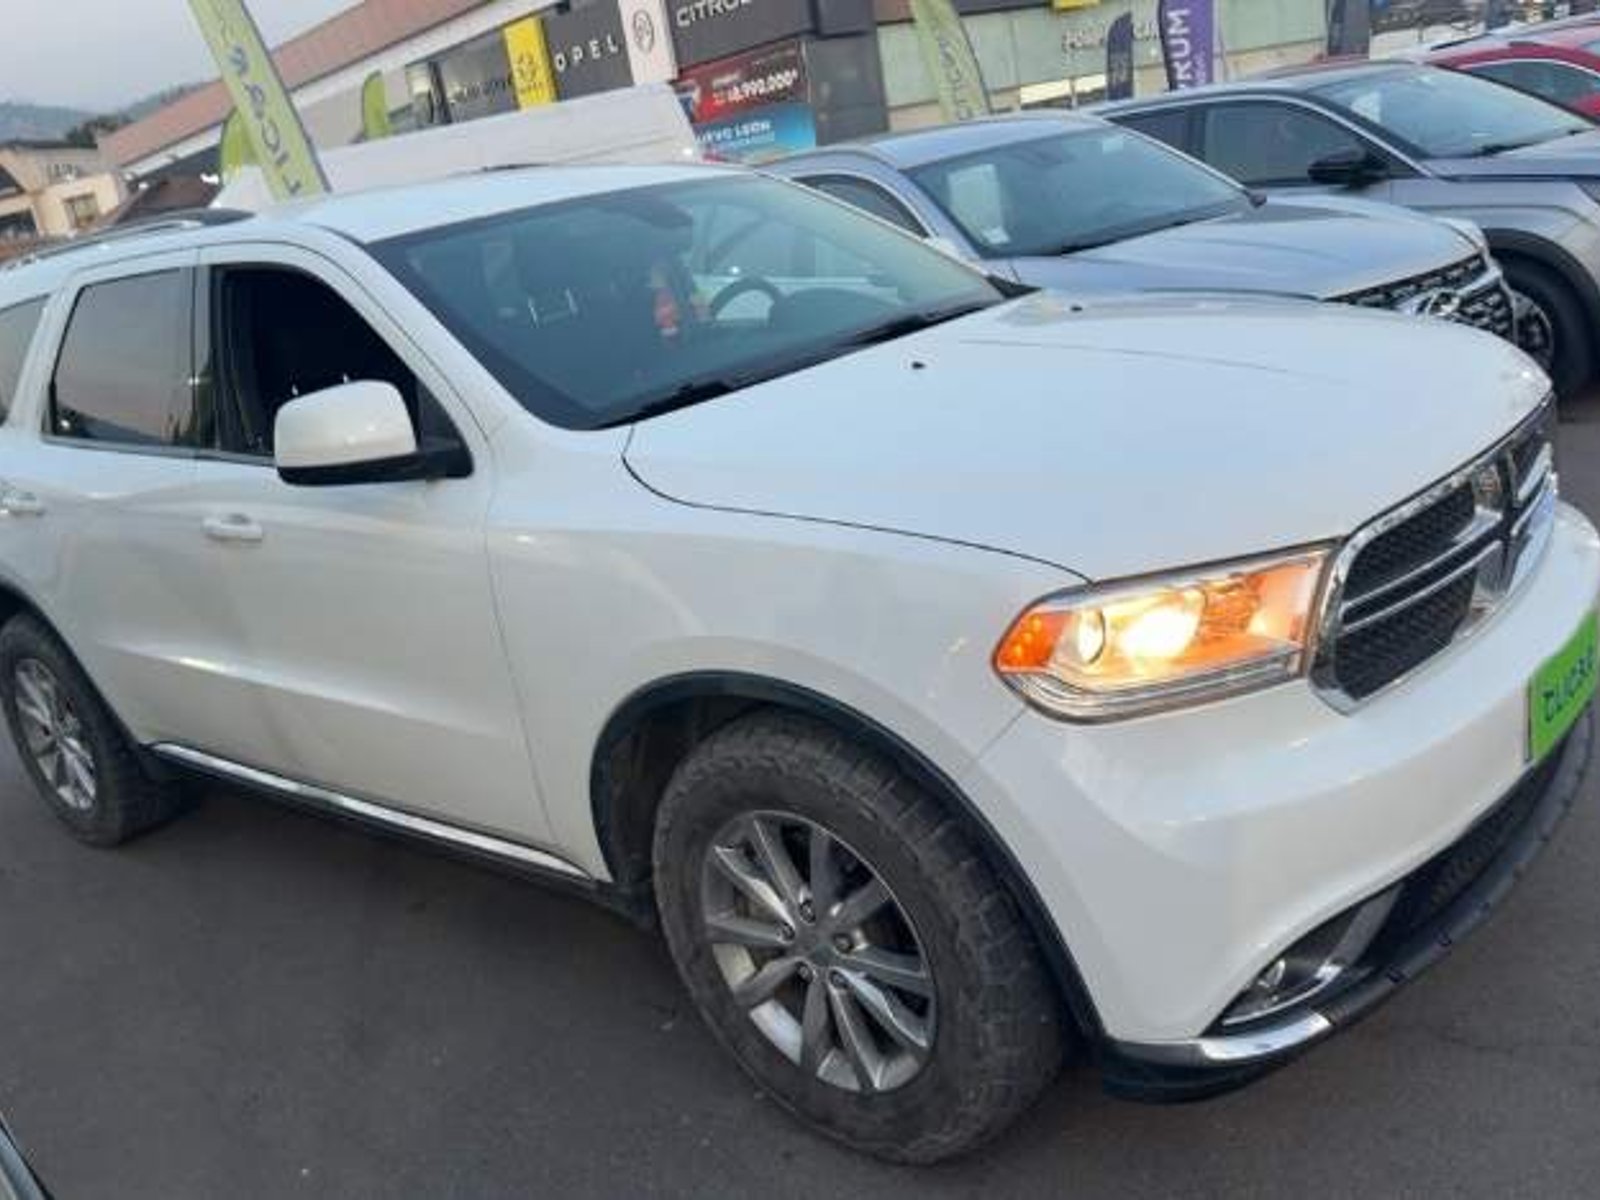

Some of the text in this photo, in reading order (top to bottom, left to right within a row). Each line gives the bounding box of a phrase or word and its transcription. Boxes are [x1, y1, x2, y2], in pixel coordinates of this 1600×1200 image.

[676, 0, 750, 27] CITRO
[555, 34, 618, 72] OPEL
[1167, 8, 1192, 88] RUM
